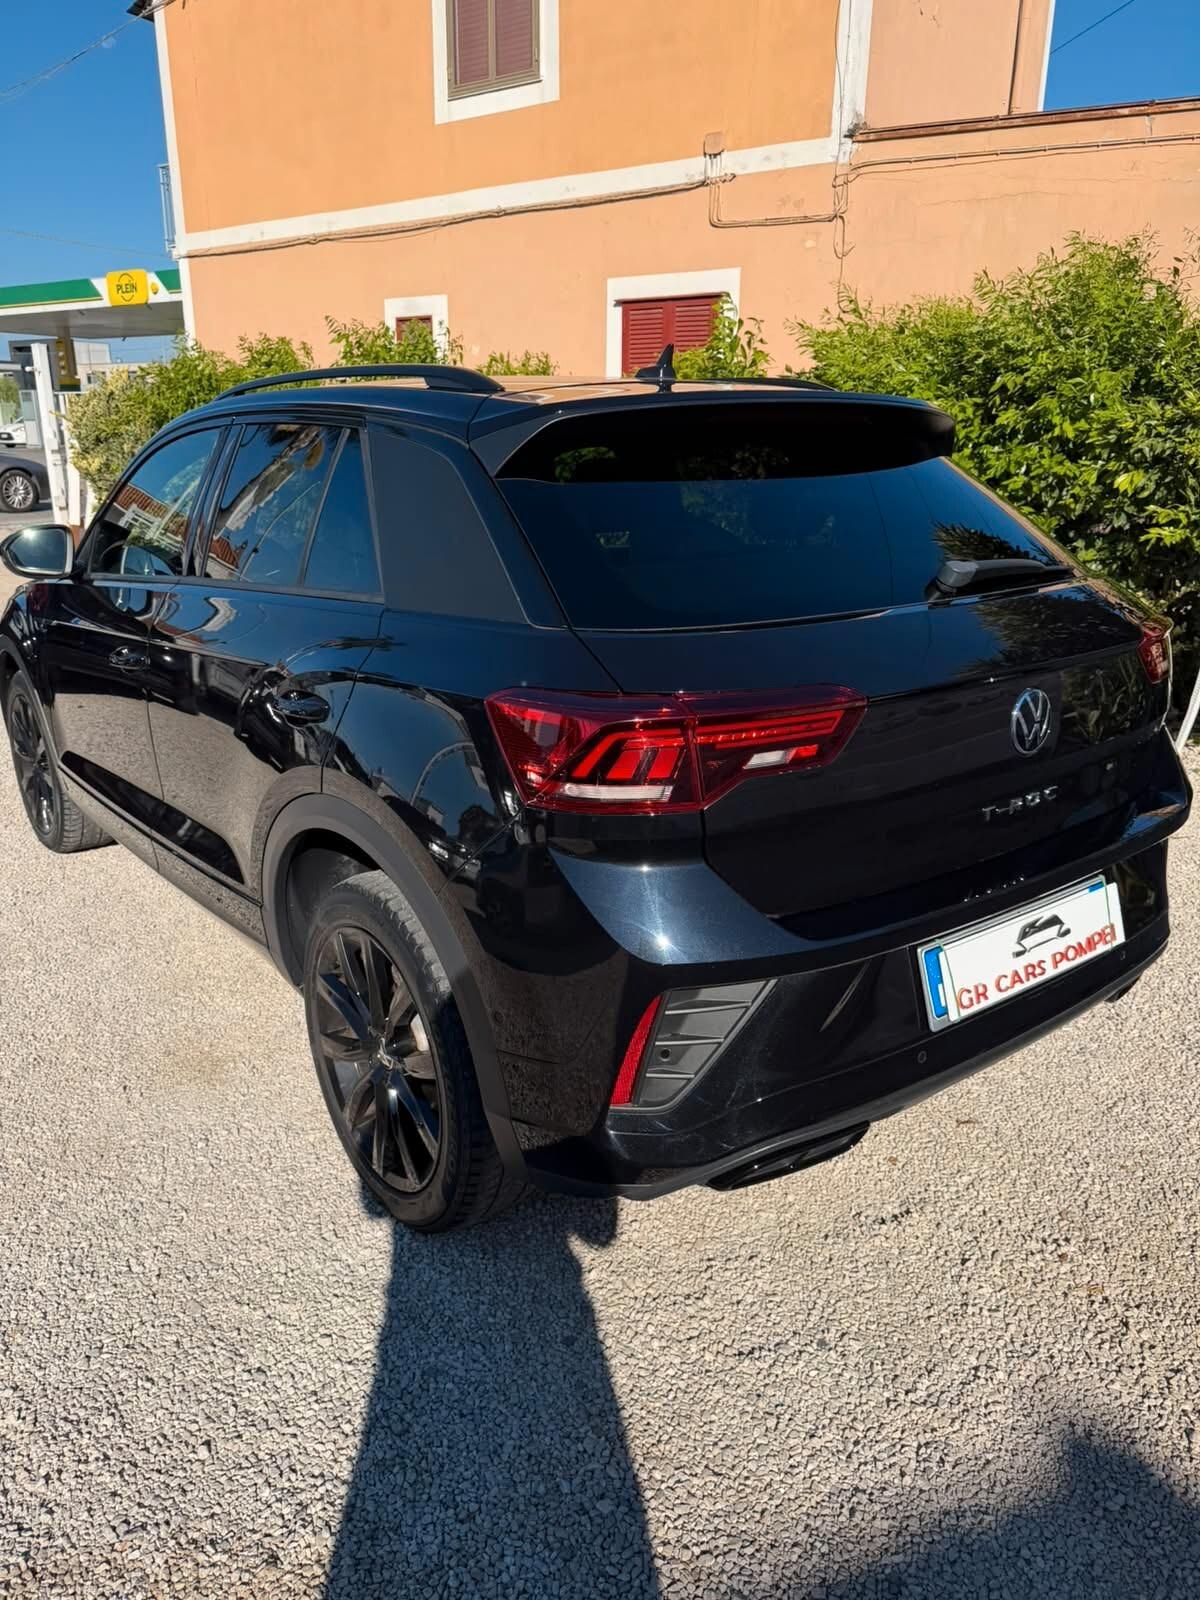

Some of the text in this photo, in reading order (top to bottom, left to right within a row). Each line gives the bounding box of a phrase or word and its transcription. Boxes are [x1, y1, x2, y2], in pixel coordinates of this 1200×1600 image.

[116, 281, 137, 295] PLEIN
[981, 786, 1058, 822] T-ROC
[957, 922, 1118, 1010] GR CARS POMPEI
